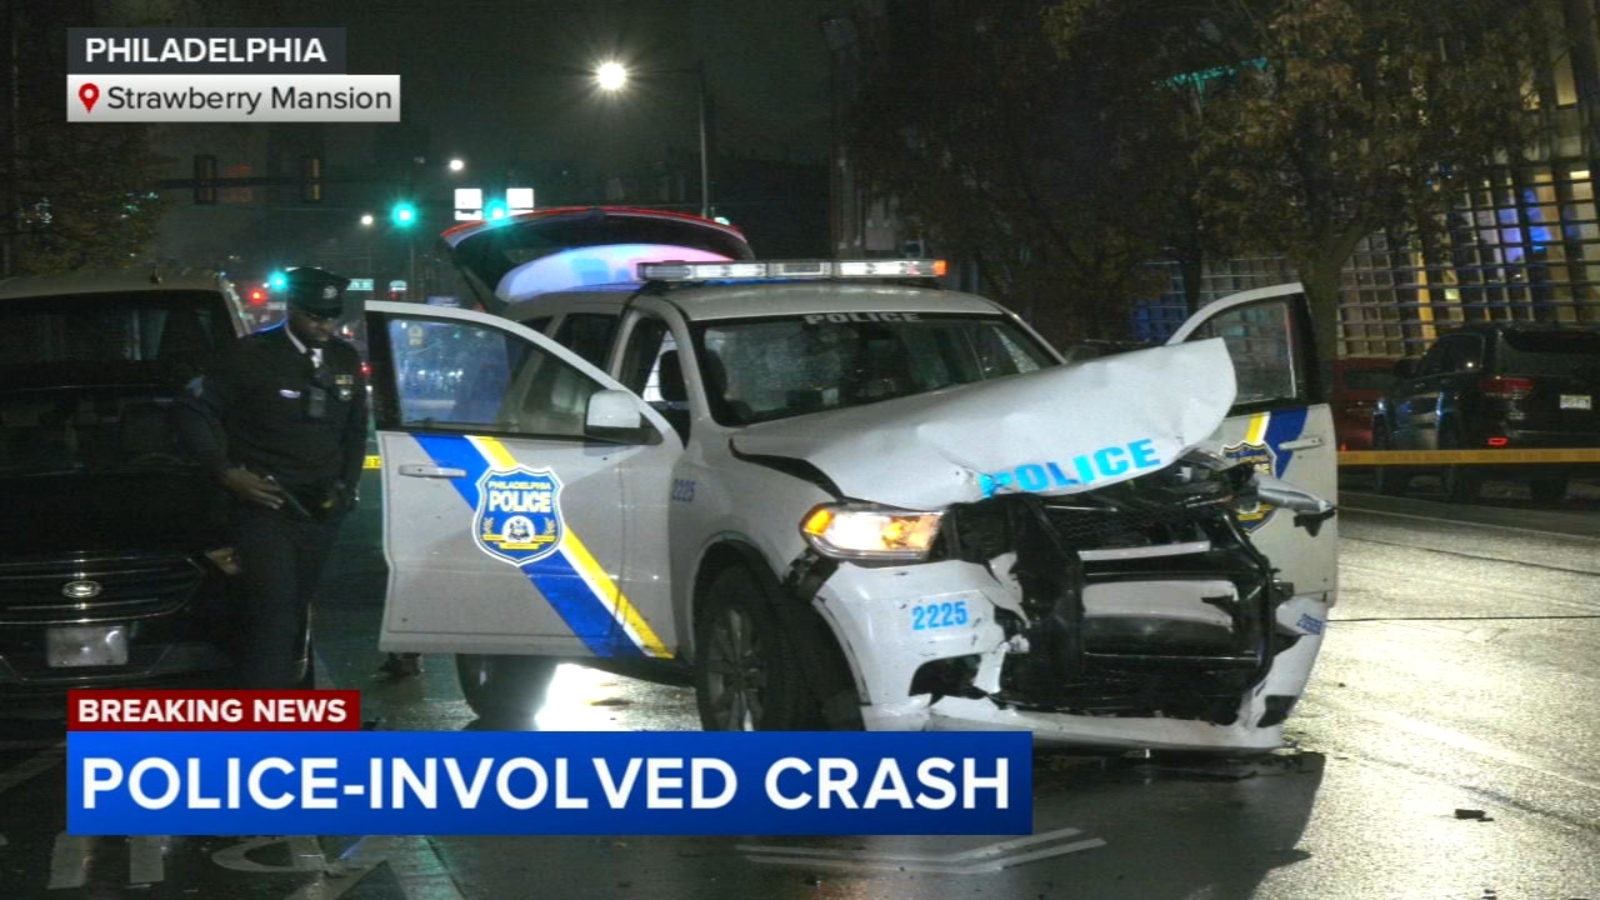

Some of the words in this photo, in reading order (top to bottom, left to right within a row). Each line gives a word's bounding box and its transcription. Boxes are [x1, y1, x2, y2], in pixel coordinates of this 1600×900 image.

[803, 311, 924, 325] POLICE
[979, 438, 1161, 499] POLICE
[489, 490, 552, 513] POLICE
[912, 600, 968, 630] 2225
